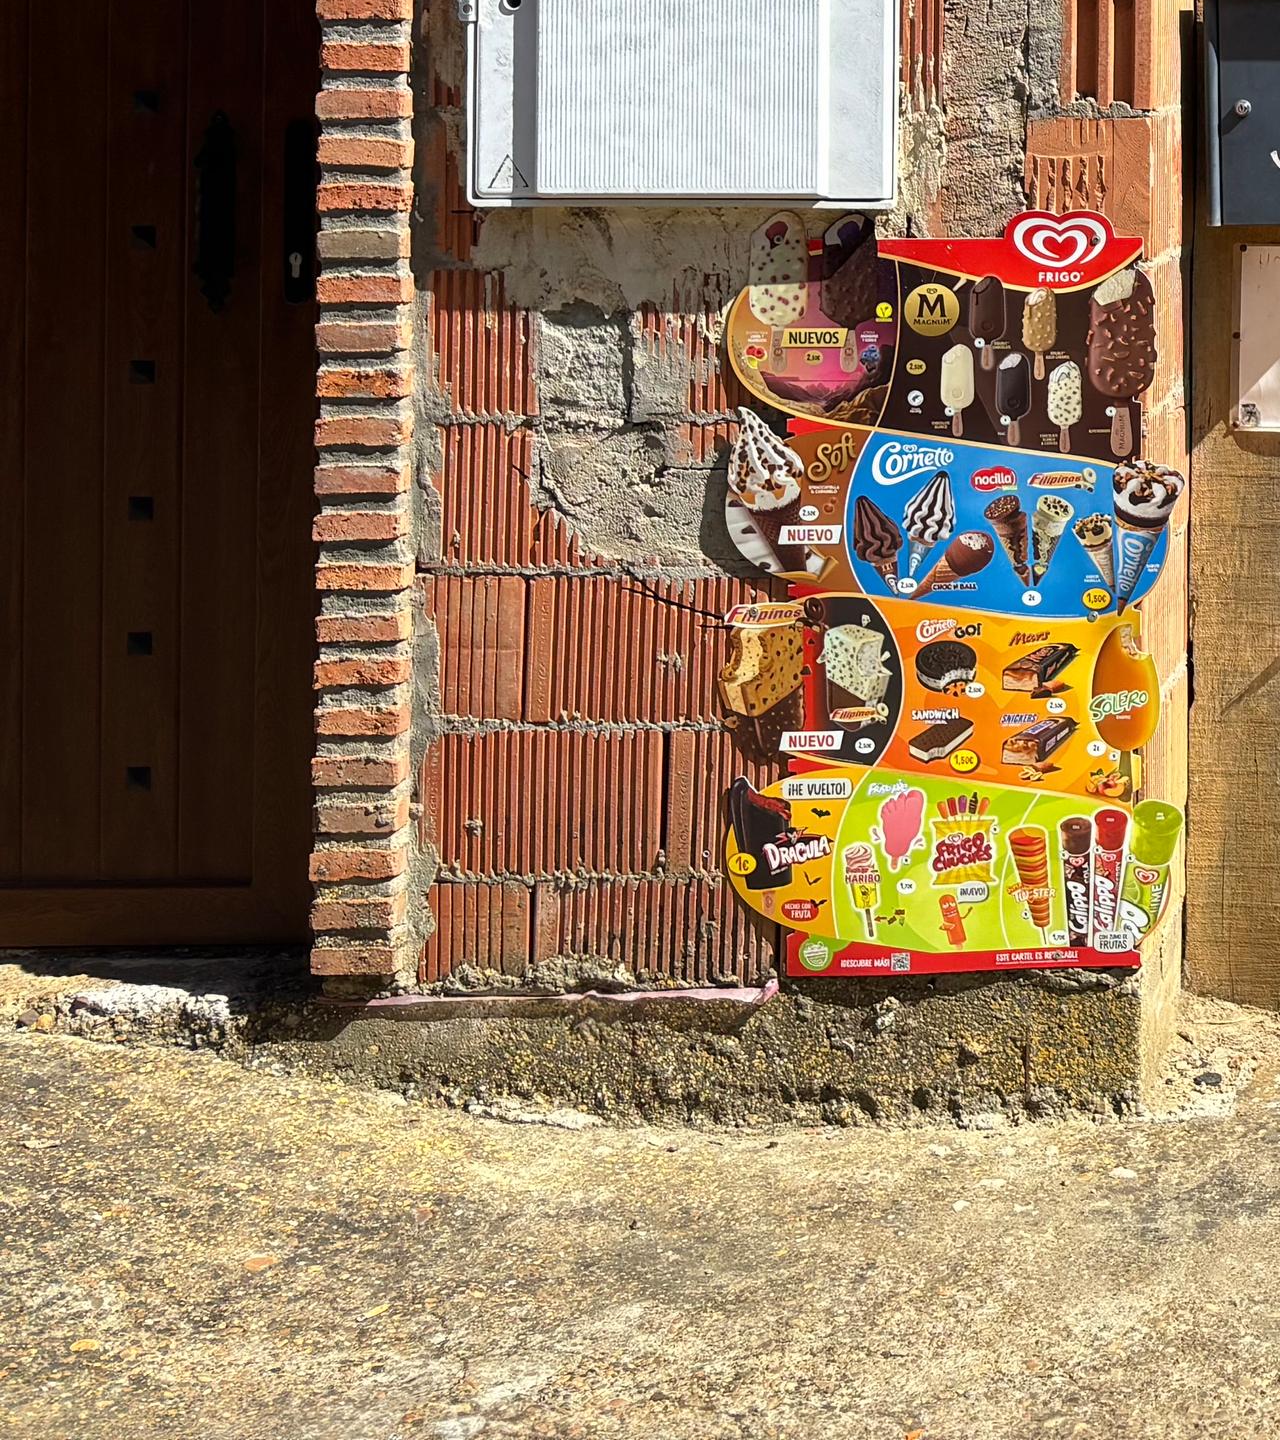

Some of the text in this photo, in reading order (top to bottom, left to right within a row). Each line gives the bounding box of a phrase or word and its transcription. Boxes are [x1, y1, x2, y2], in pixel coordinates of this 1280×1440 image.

[1038, 272, 1081, 283] FRIGO
[913, 318, 950, 326] MAGNUM
[788, 331, 840, 345] NUEVOS
[807, 431, 857, 483] Soft
[871, 441, 955, 486] Cornetto
[974, 472, 1012, 486] nocilla
[1029, 472, 1083, 486] Filipinos
[787, 529, 833, 542] NUEVO
[1086, 593, 1107, 604] 1,50€
[1009, 631, 1050, 646] Mars
[1089, 690, 1148, 721] SOLERO
[832, 710, 876, 720] Filipinos
[1001, 714, 1038, 724] SNICKERS
[788, 735, 834, 748] NUEVO
[954, 756, 974, 766] 1,50€
[788, 782, 846, 796] ¡HE VUELTO!
[763, 836, 832, 870] DRACULA
[736, 856, 749, 871] 1€
[845, 873, 880, 884] HARIBO
[960, 887, 986, 897] ¡NUEVO!
[1066, 880, 1089, 934] Calippo
[1094, 875, 1115, 932] Calippo
[791, 910, 812, 919] FRUTA
[1099, 939, 1128, 950] FRUTAS
[996, 953, 1010, 962] ESTE
[1011, 952, 1034, 961] CARTEL
[1035, 952, 1043, 960] ES
